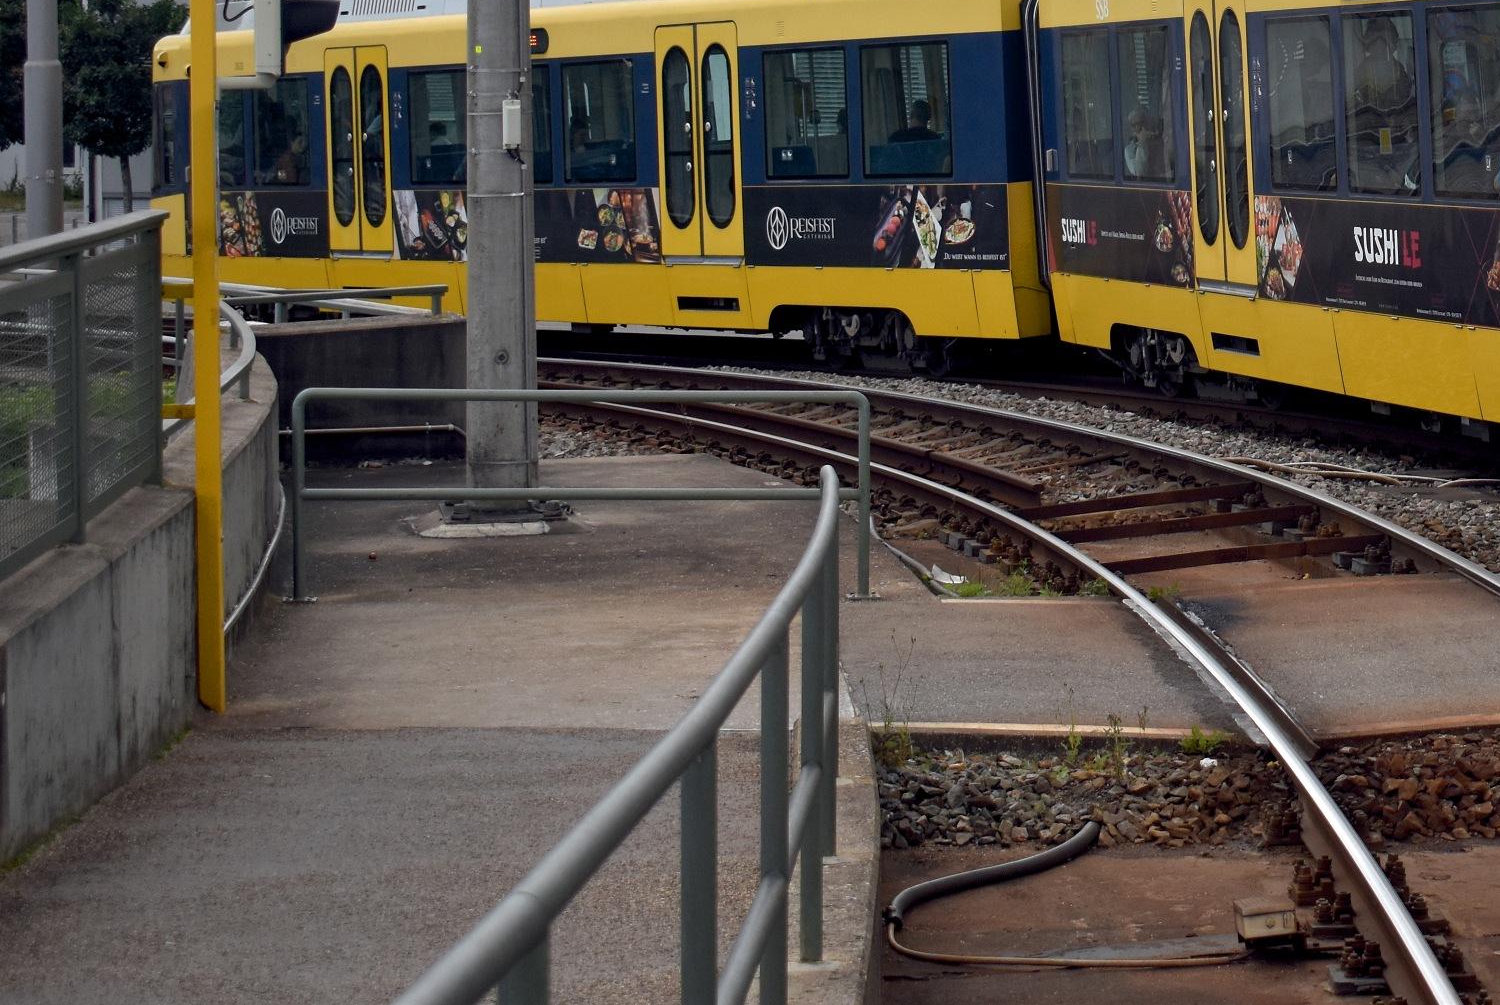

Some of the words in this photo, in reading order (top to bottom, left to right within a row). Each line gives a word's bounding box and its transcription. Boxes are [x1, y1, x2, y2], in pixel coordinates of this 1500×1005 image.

[1061, 218, 1086, 244] SUSHI
[1353, 226, 1400, 265] SUSHI
[1402, 229, 1422, 269] LE
